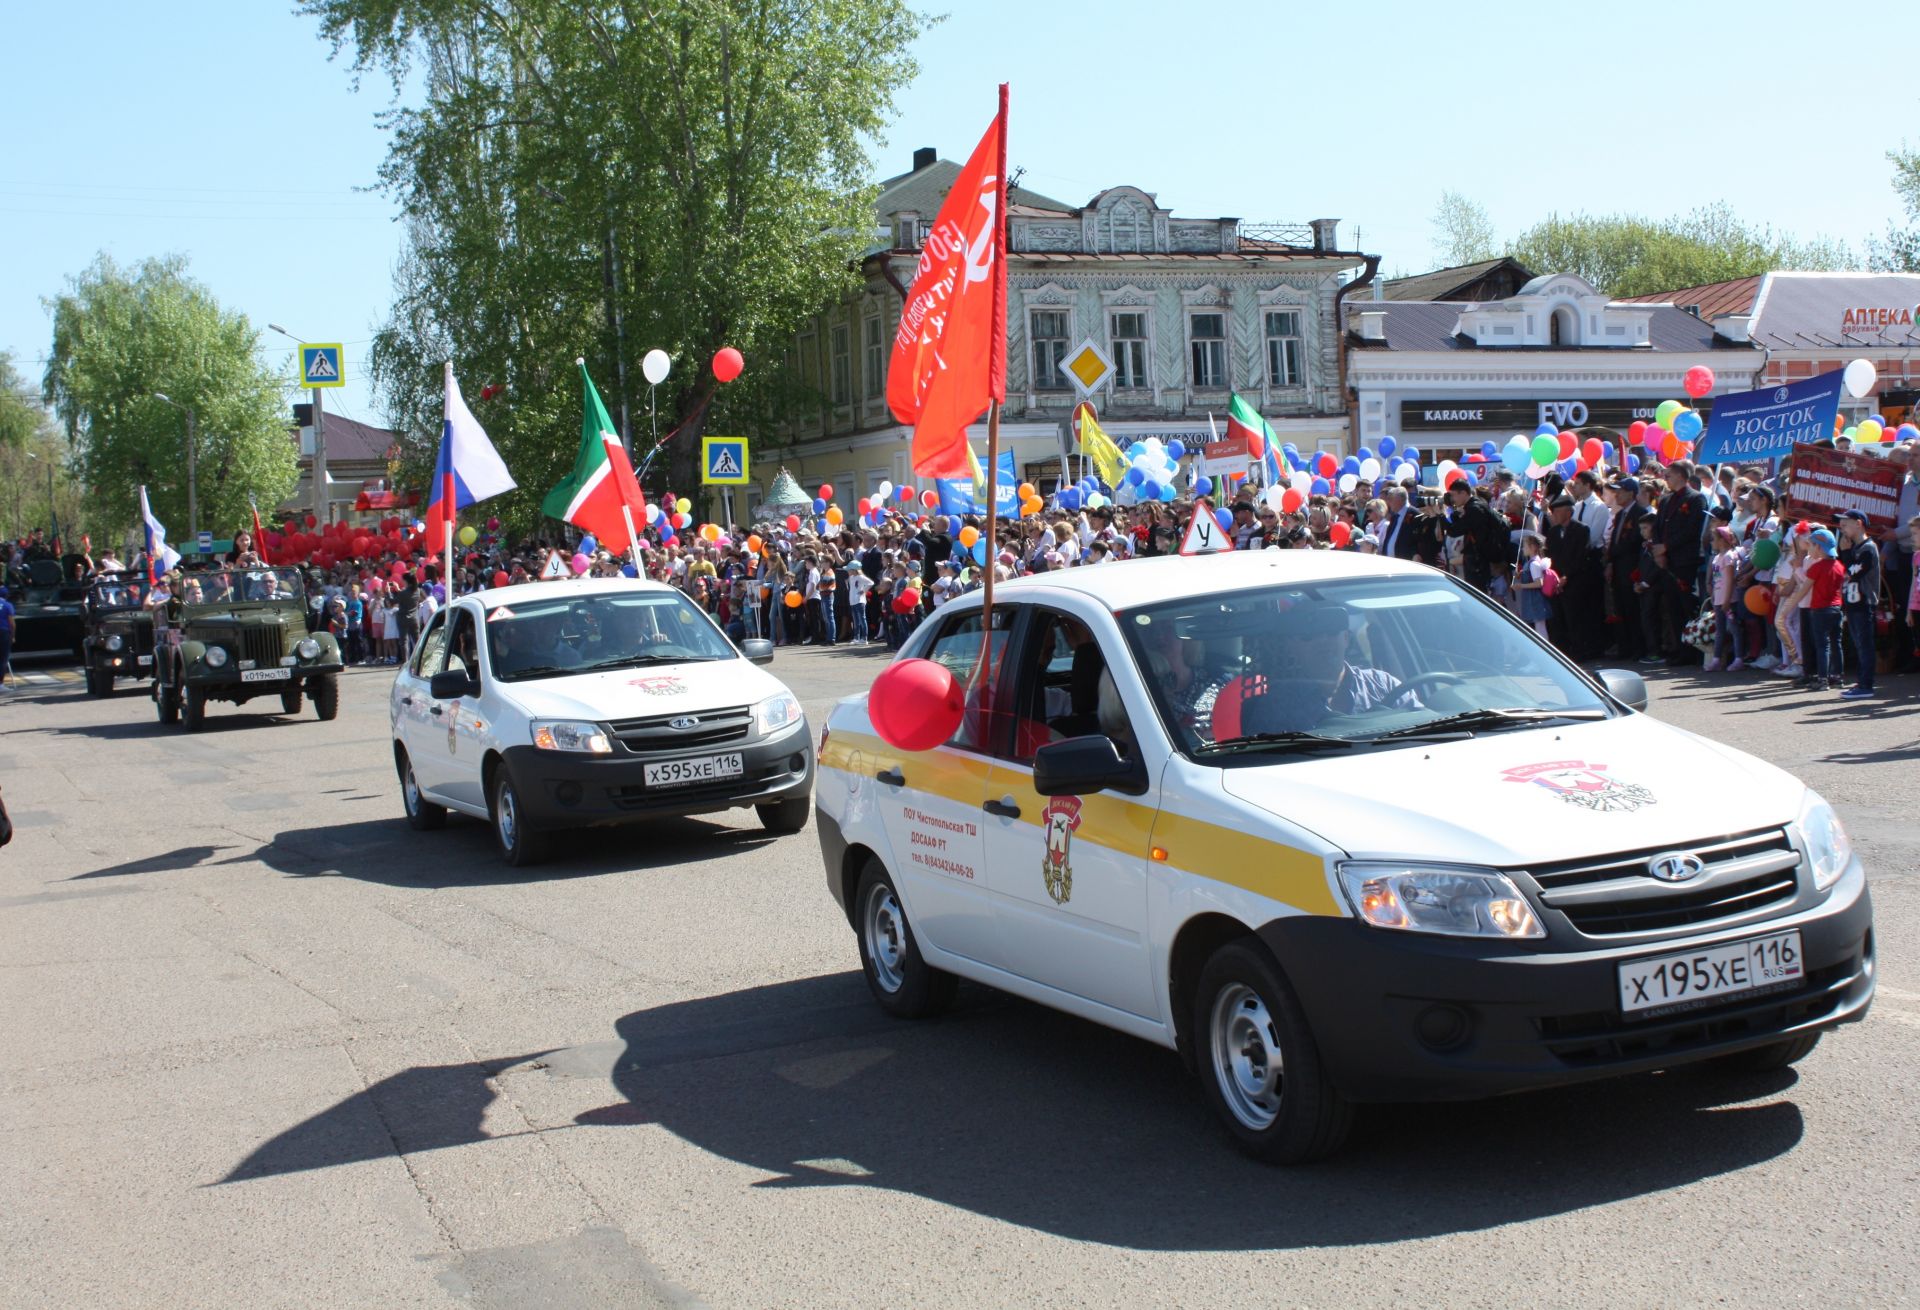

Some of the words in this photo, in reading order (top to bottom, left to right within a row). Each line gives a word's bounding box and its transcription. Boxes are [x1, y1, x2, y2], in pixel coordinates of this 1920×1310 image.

[1843, 308, 1911, 325] АПТЕКА
[1424, 410, 1483, 421] KARAOKE
[1538, 401, 1589, 426] EVO
[1733, 405, 1816, 436] ВОСТОК
[1717, 422, 1824, 456] АМФИБИЯ
[1476, 464, 1487, 480] 9
[1796, 468, 1811, 479] ОАО
[1873, 484, 1897, 498] ЗАВОД
[650, 762, 712, 783] Х595ХЕ
[716, 755, 739, 769] 116
[903, 806, 916, 820] ПОУ
[917, 811, 964, 834] Чистопольская
[965, 823, 977, 837] ТШ
[911, 831, 937, 848] ДОСААФ
[938, 839, 947, 851] РТ
[911, 852, 923, 864] тел.
[924, 854, 974, 880] 8(84342)4-06-29
[1631, 956, 1748, 1004] Х195ХЕ
[1753, 937, 1795, 969] 116
[1763, 966, 1785, 979] RUS
